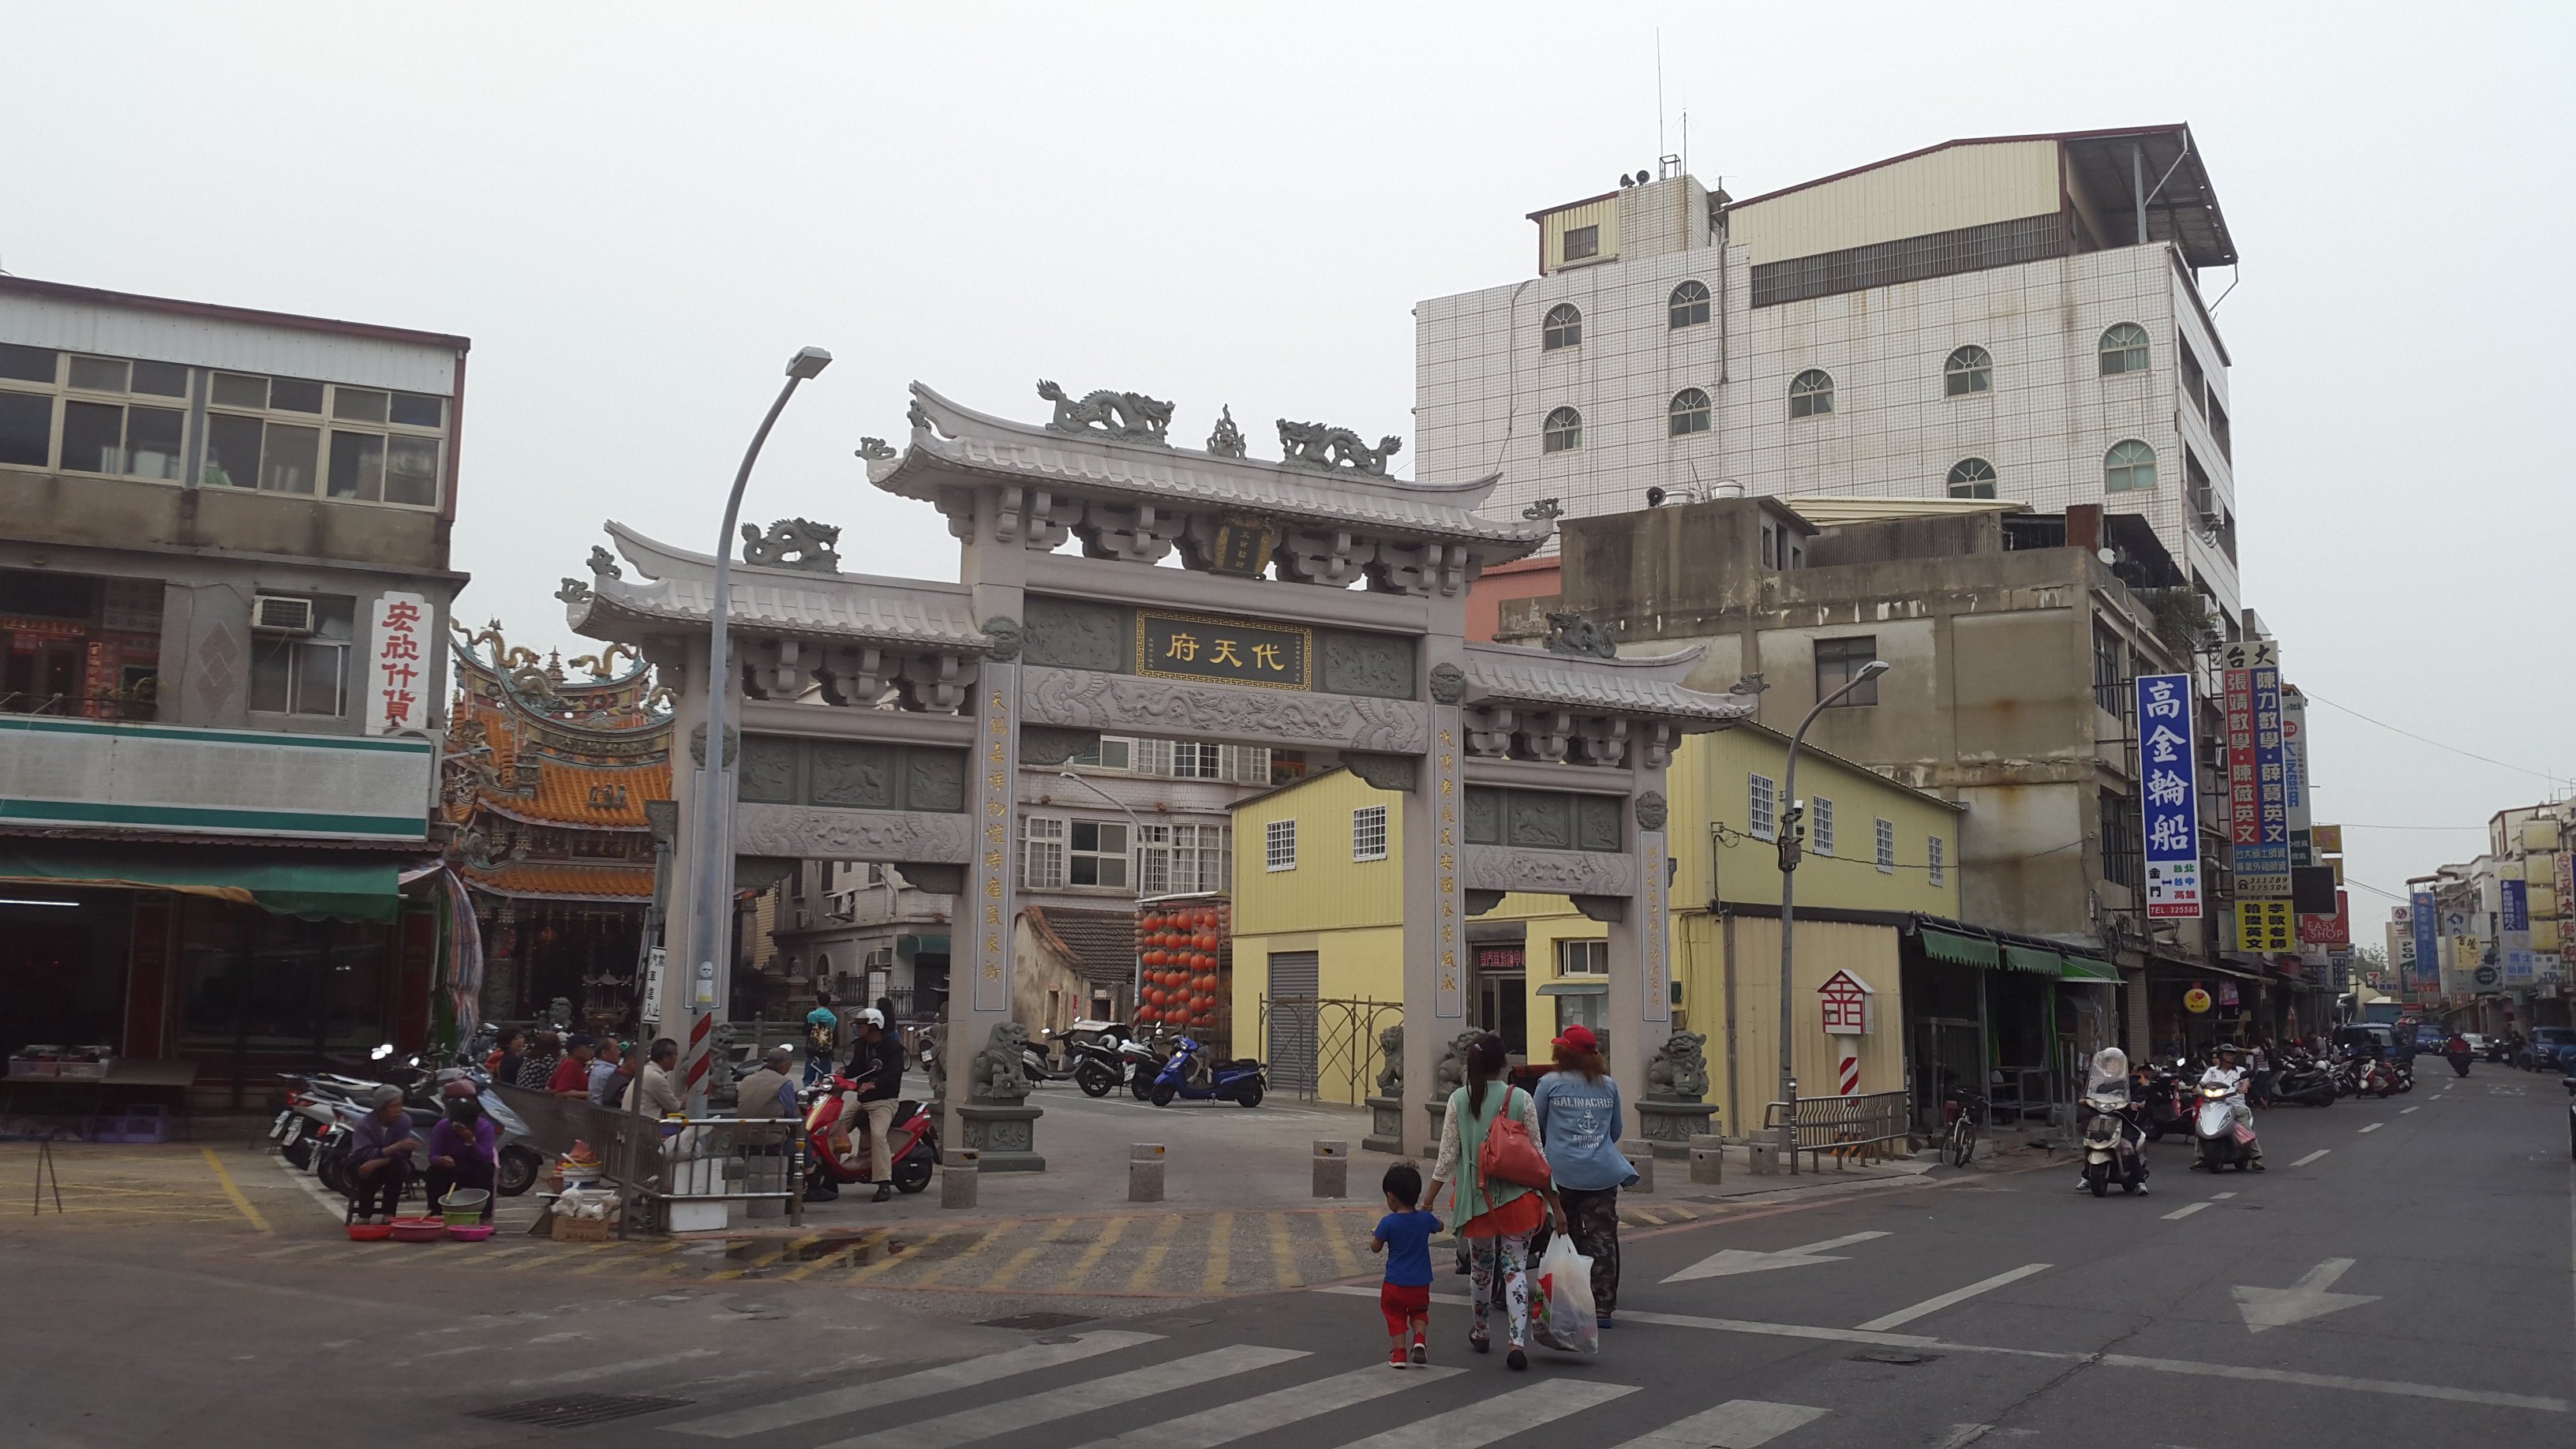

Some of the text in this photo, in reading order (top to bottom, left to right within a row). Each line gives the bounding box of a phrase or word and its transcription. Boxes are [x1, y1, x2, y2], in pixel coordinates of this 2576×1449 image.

[1166, 633, 1285, 671] 代天府
[2226, 644, 2275, 668] 台大
[380, 601, 421, 728] 宏欣什貨
[2146, 680, 2189, 852] 高金輪船
[2174, 863, 2195, 873] 台北
[2148, 868, 2161, 897] 金門
[2174, 877, 2195, 886] 台中
[2174, 889, 2196, 900] 高雄
[2308, 922, 2336, 930] EASY
[2310, 929, 2343, 938] SHOP
